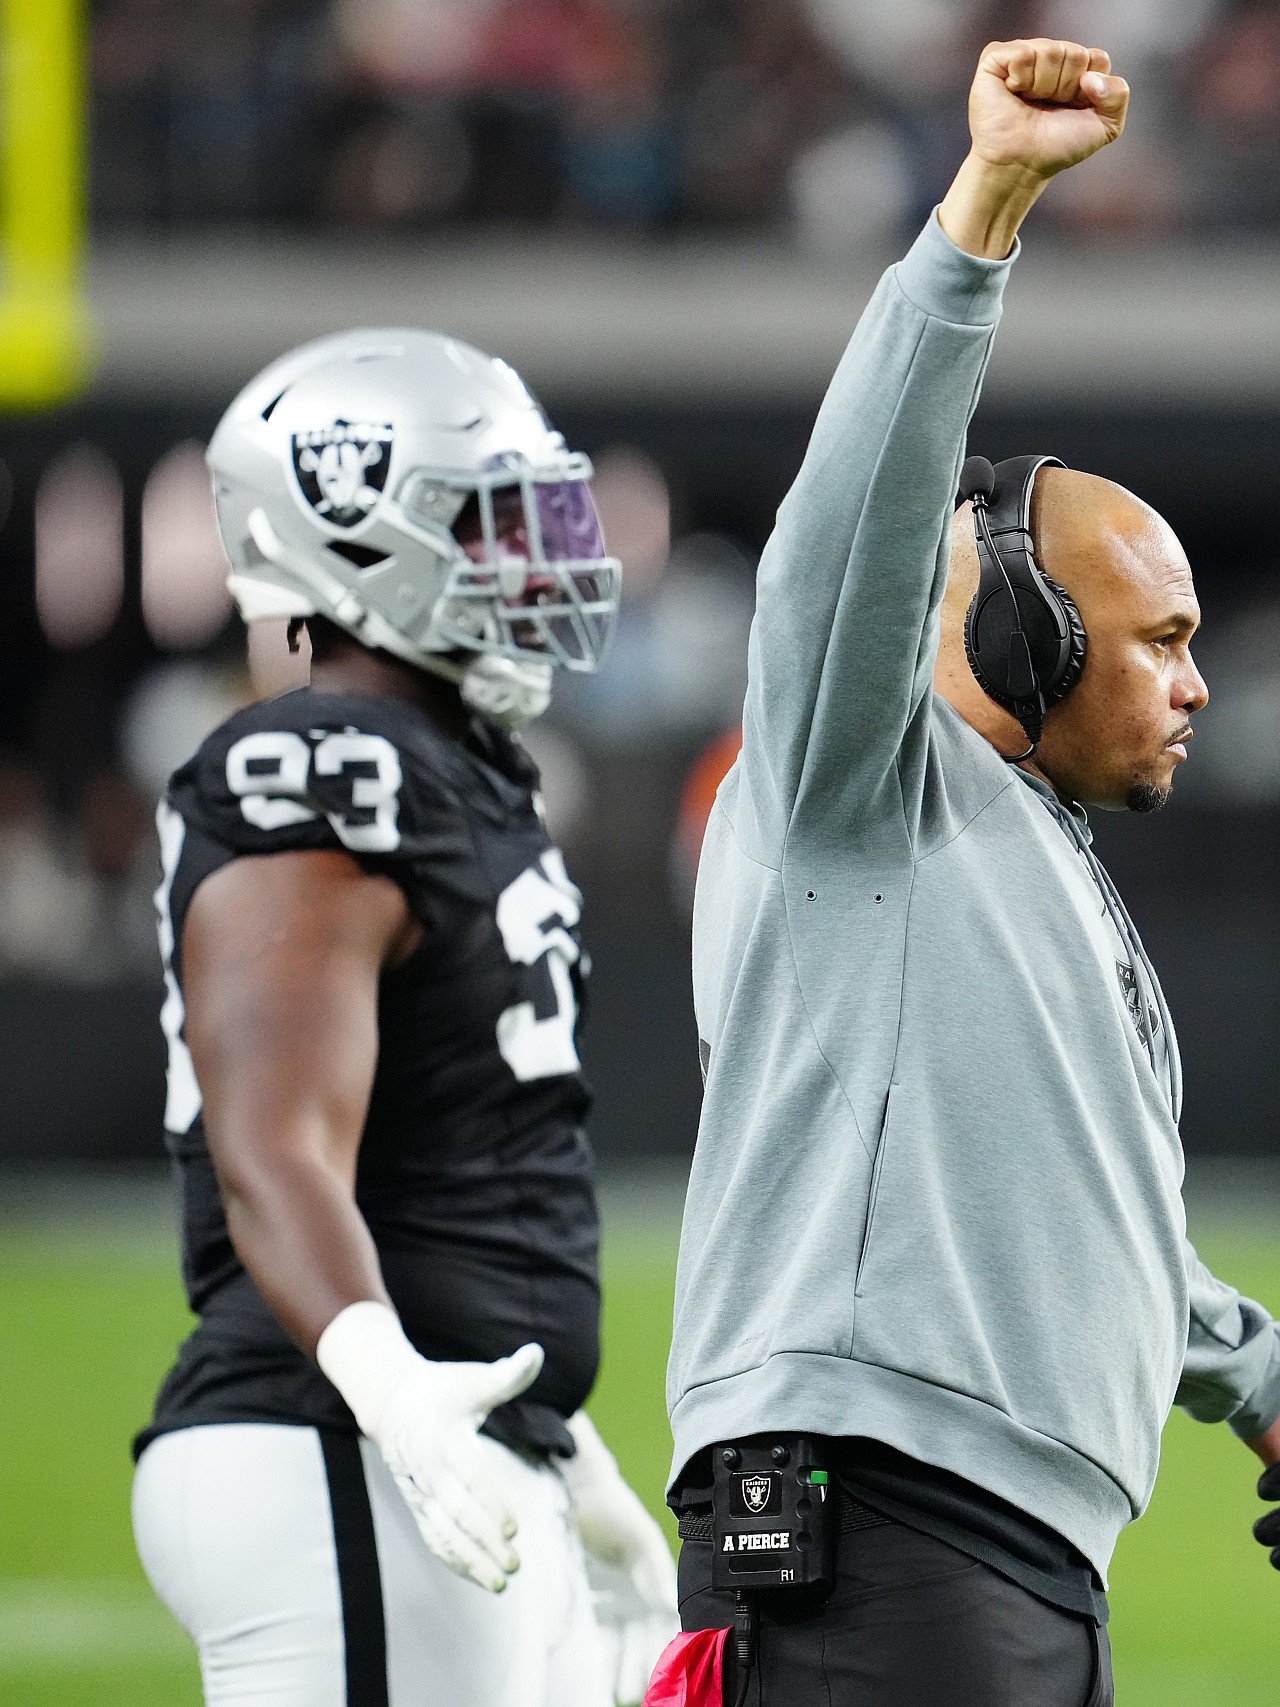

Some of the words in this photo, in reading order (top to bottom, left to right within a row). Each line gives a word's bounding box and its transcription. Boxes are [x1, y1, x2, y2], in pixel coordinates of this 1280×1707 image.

[226, 730, 402, 852] 93
[723, 1535, 735, 1552] A
[738, 1532, 790, 1551] PIERCE
[781, 1568, 795, 1582] R1
